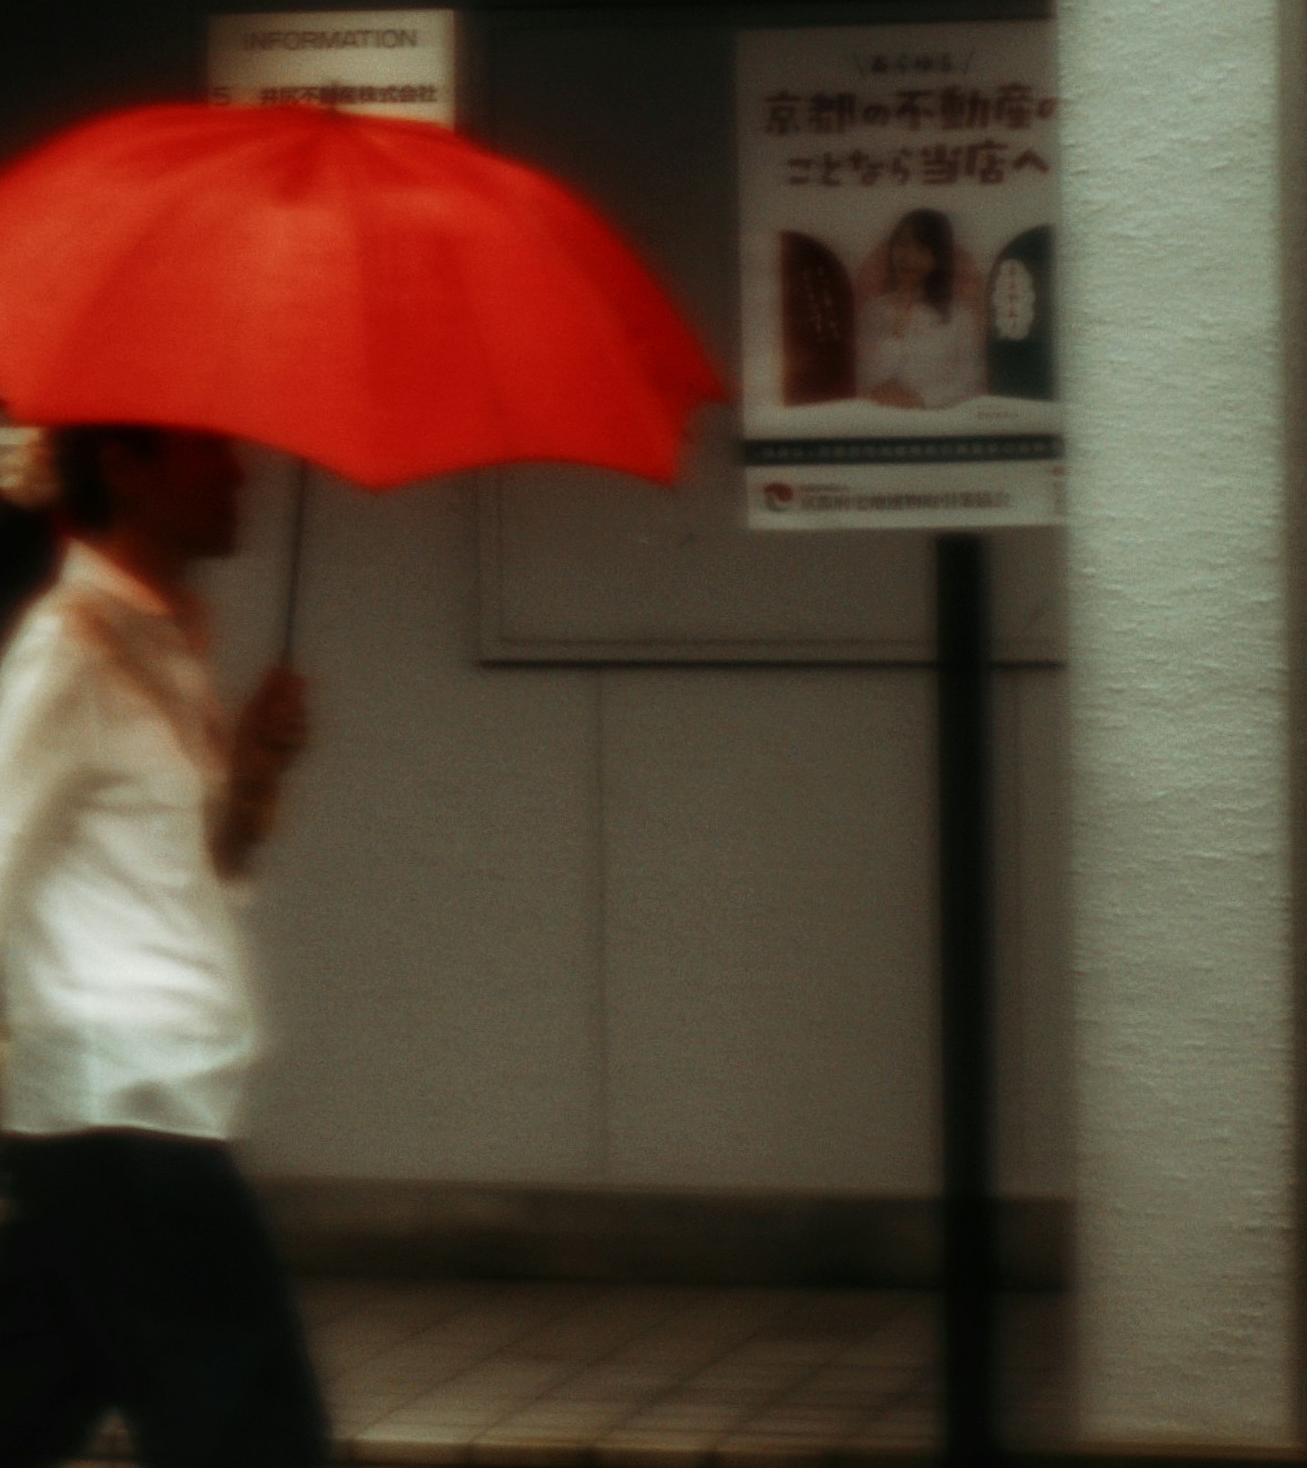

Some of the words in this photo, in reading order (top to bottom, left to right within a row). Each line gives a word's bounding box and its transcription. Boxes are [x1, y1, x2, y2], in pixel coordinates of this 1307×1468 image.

[245, 29, 417, 49] INFORMATION
[788, 139, 1050, 186] ことなら当店へ
